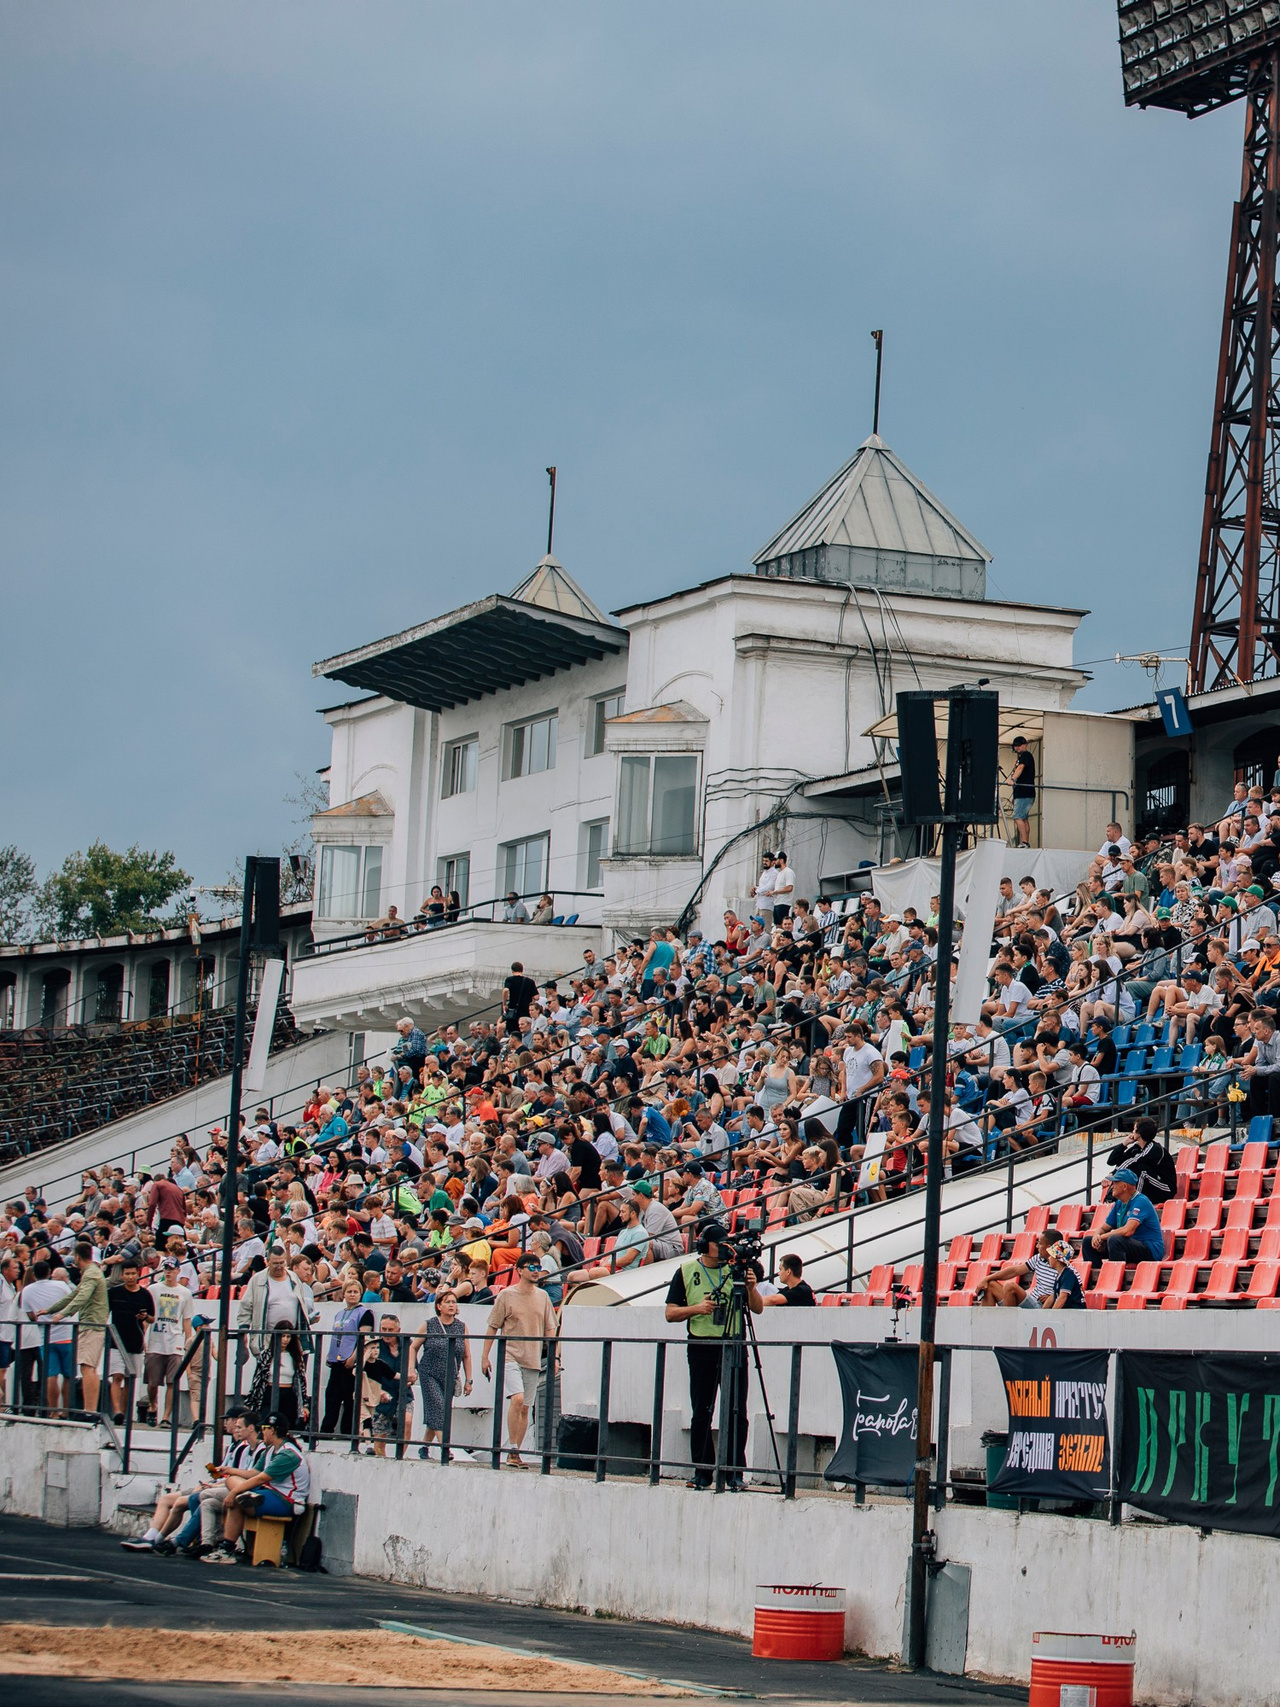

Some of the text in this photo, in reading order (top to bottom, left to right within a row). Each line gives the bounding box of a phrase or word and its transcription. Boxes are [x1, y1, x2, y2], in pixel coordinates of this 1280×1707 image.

[1164, 695, 1180, 729] 7
[693, 1271, 701, 1286] 3
[1055, 1380, 1106, 1420] ИРКУТС
